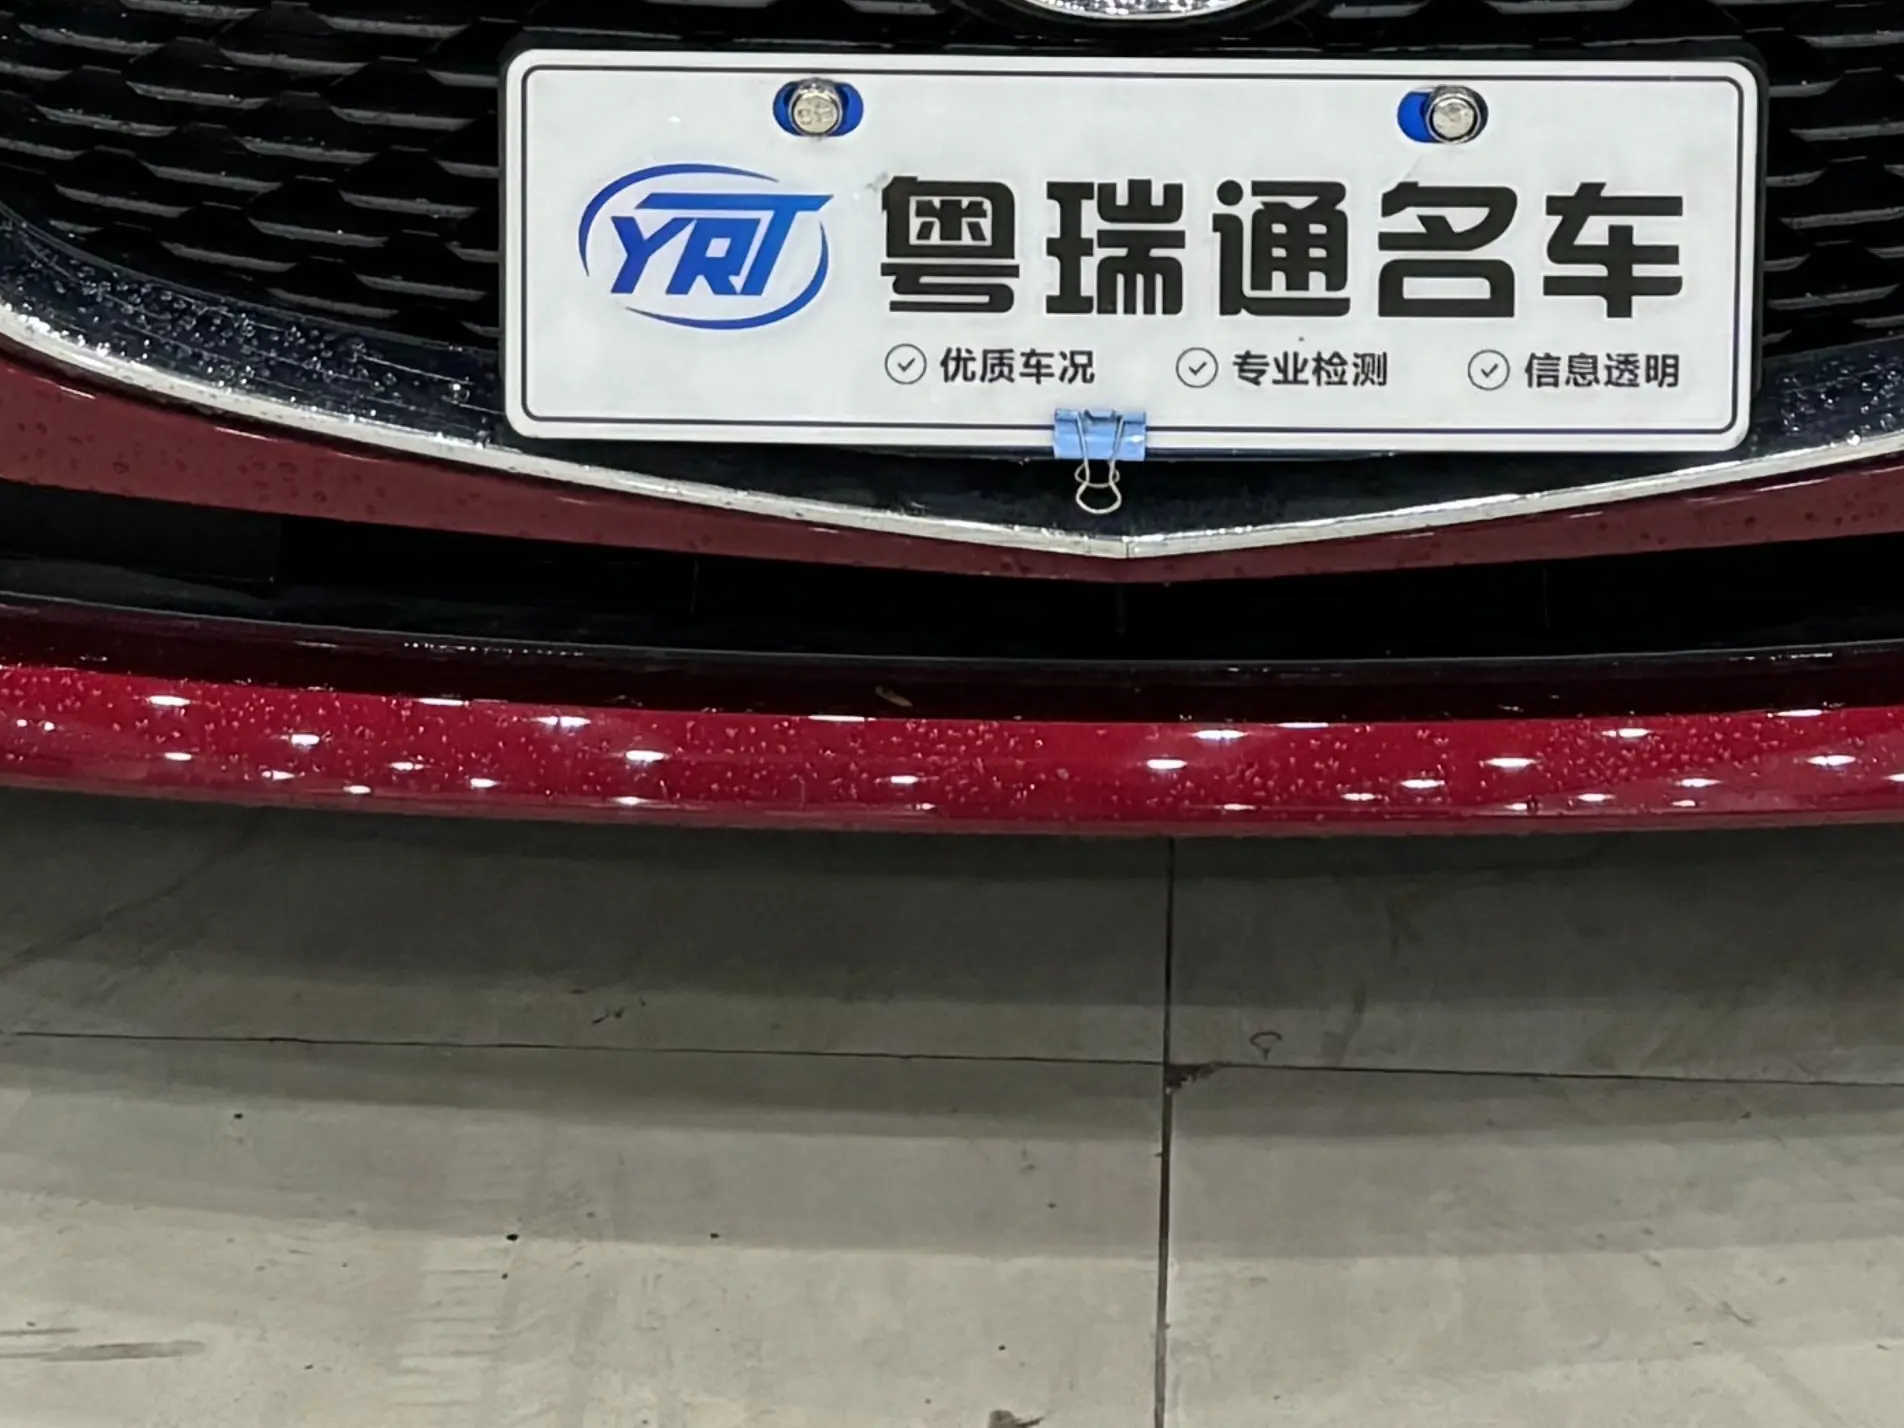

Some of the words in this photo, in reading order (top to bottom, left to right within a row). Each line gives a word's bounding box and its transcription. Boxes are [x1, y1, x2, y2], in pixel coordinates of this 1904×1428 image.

[610, 192, 834, 296] YRT
[880, 175, 1685, 320] 粤瑞通名车
[939, 347, 1097, 387] 优质车况
[1233, 350, 1390, 389] 专业检测
[1524, 352, 1682, 390] 信息透明
